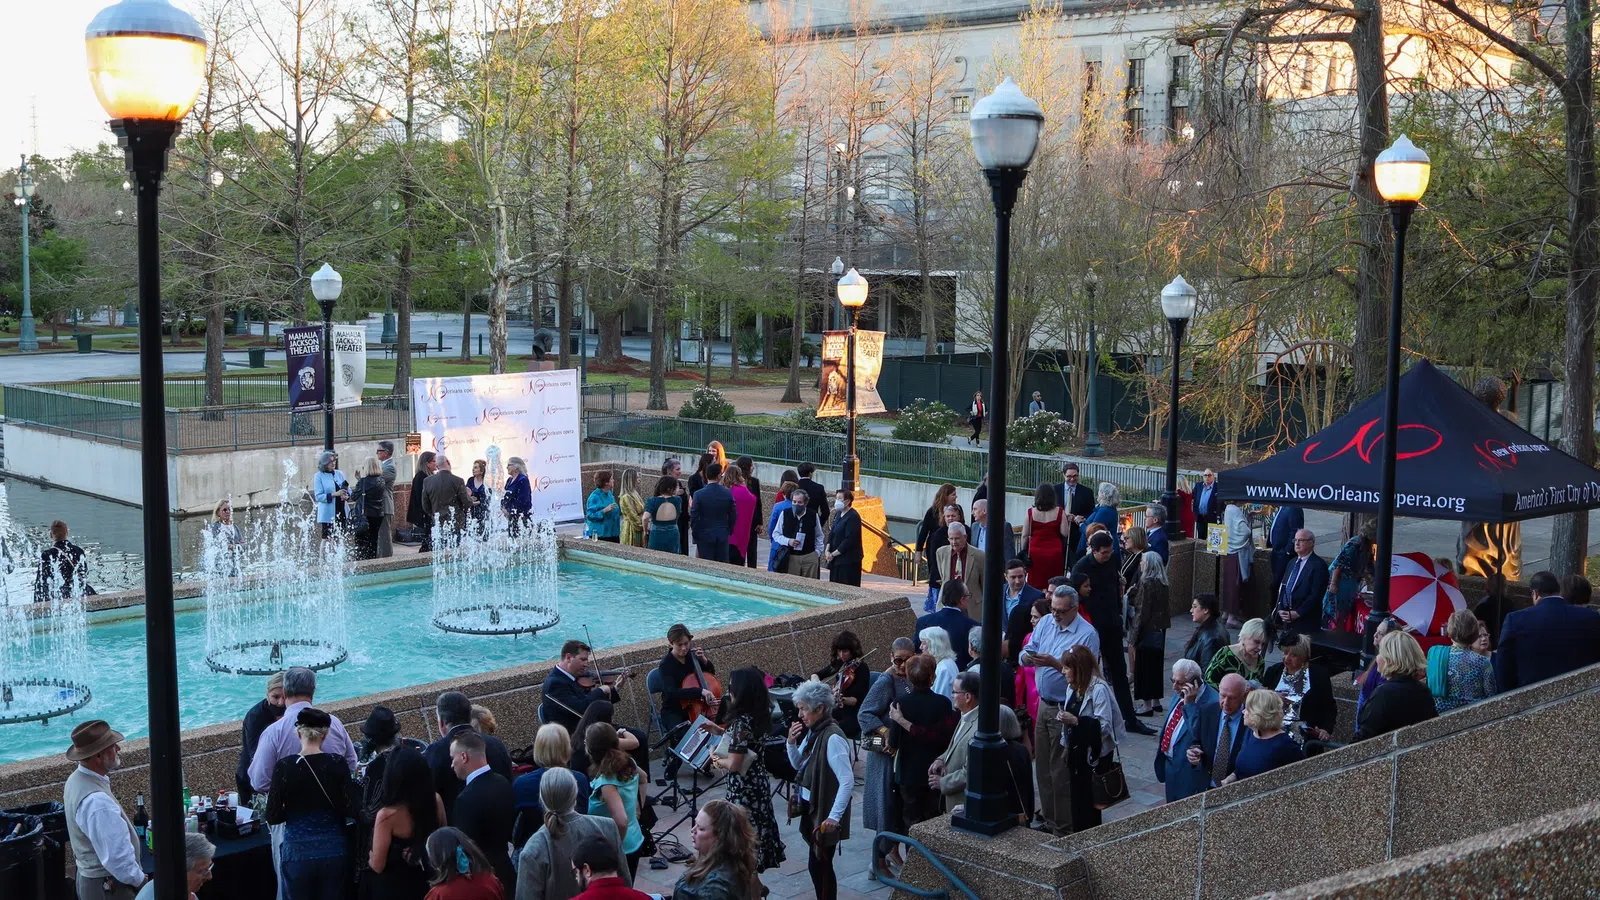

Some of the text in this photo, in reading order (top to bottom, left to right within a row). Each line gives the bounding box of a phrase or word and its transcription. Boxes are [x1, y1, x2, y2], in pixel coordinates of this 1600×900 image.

[288, 332, 318, 340] MAHALIA
[290, 338, 319, 347] JACKSON
[290, 345, 320, 355] THEATER
[1492, 446, 1510, 458] new
[1246, 482, 1466, 512] www.NewOrleanspera.org
[1514, 488, 1548, 511] America's
[1549, 486, 1566, 504] First
[1567, 484, 1581, 504] City
[1582, 482, 1590, 503] of
